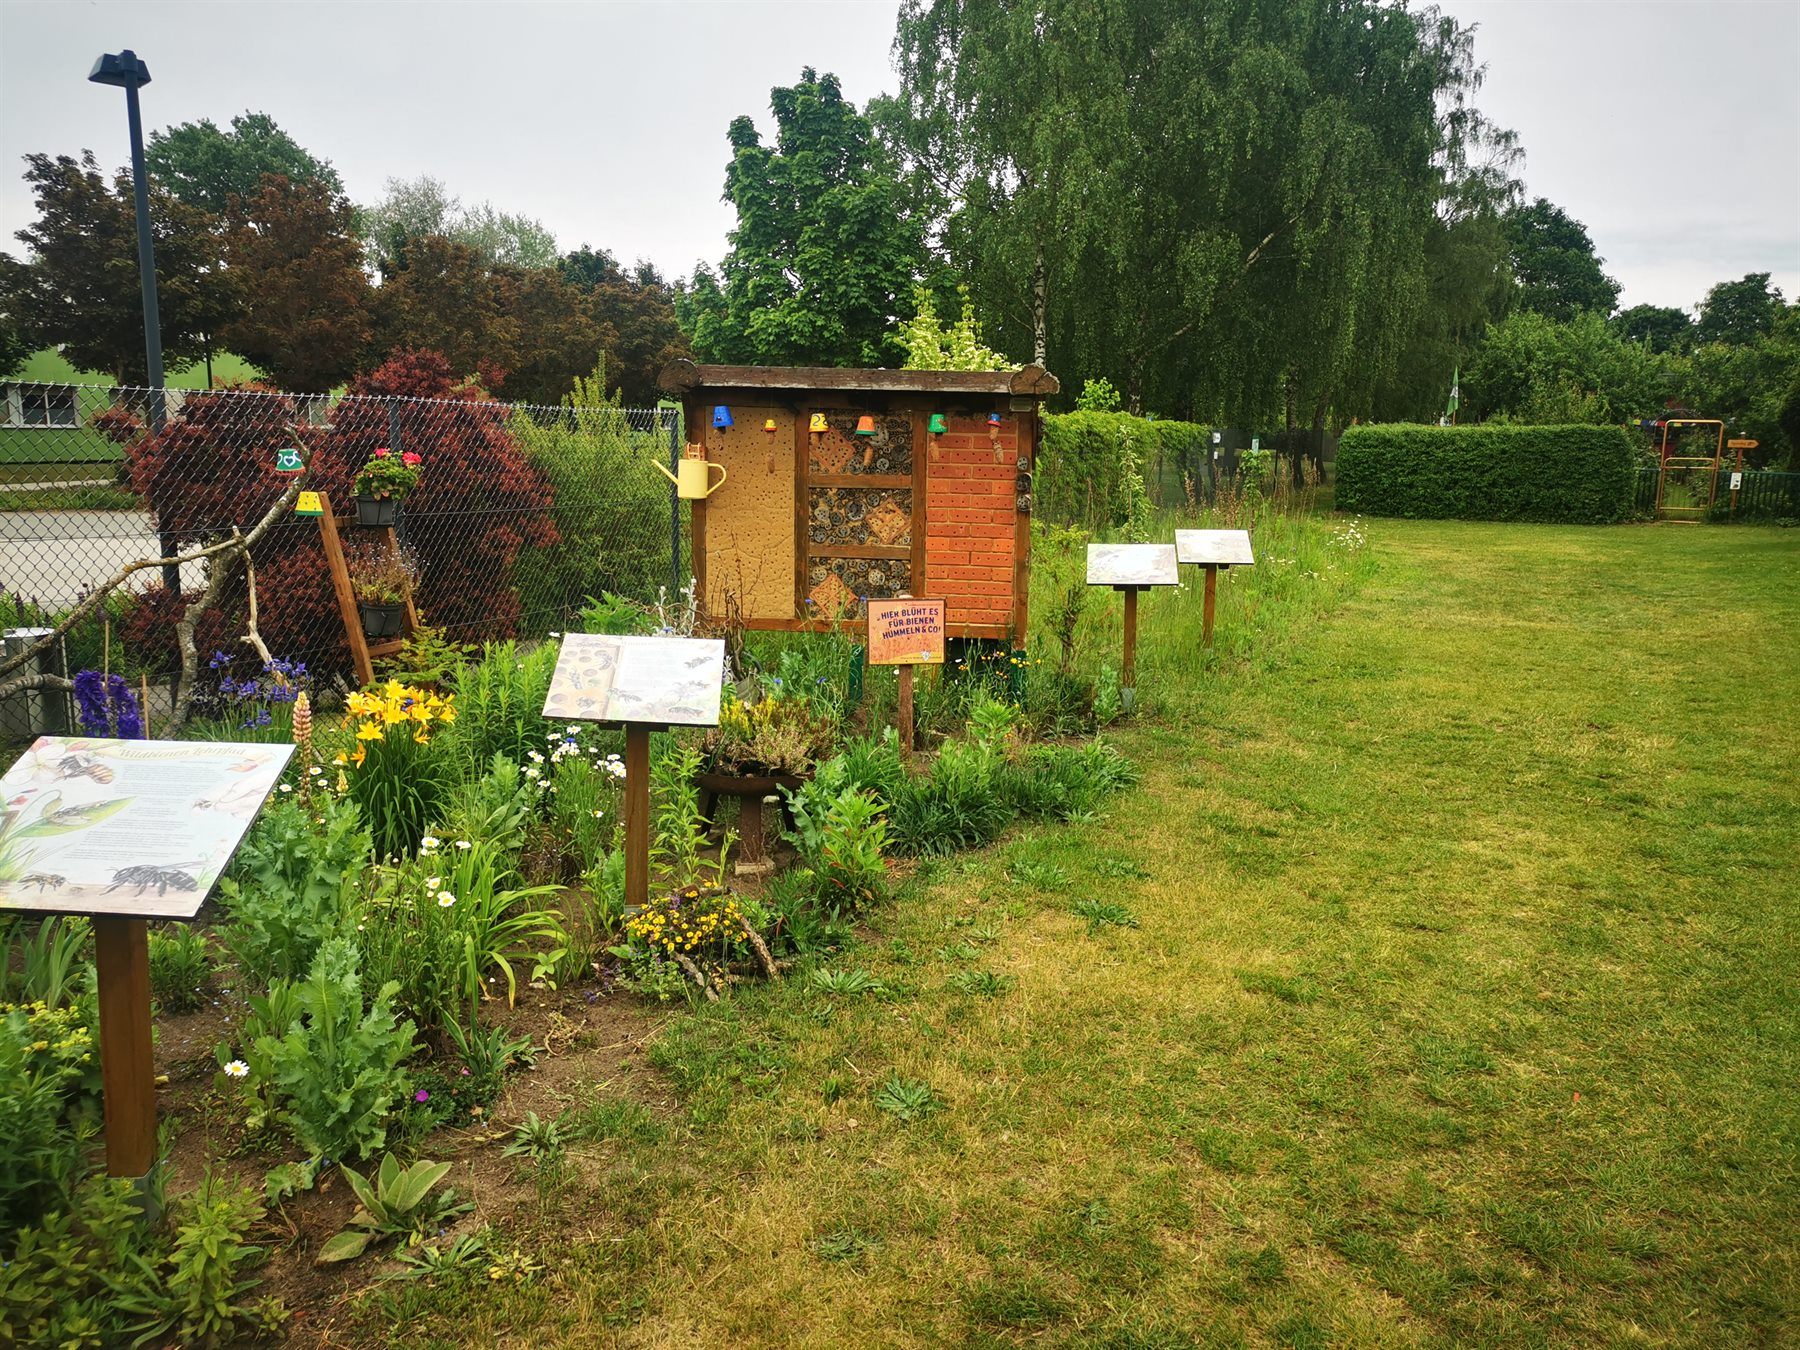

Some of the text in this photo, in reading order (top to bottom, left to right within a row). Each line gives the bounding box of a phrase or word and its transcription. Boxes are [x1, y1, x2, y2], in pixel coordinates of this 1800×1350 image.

[901, 607, 927, 616] BLÜHT
[888, 617, 935, 628] FÜR BIENEN
[882, 626, 921, 640] HUMMELN
